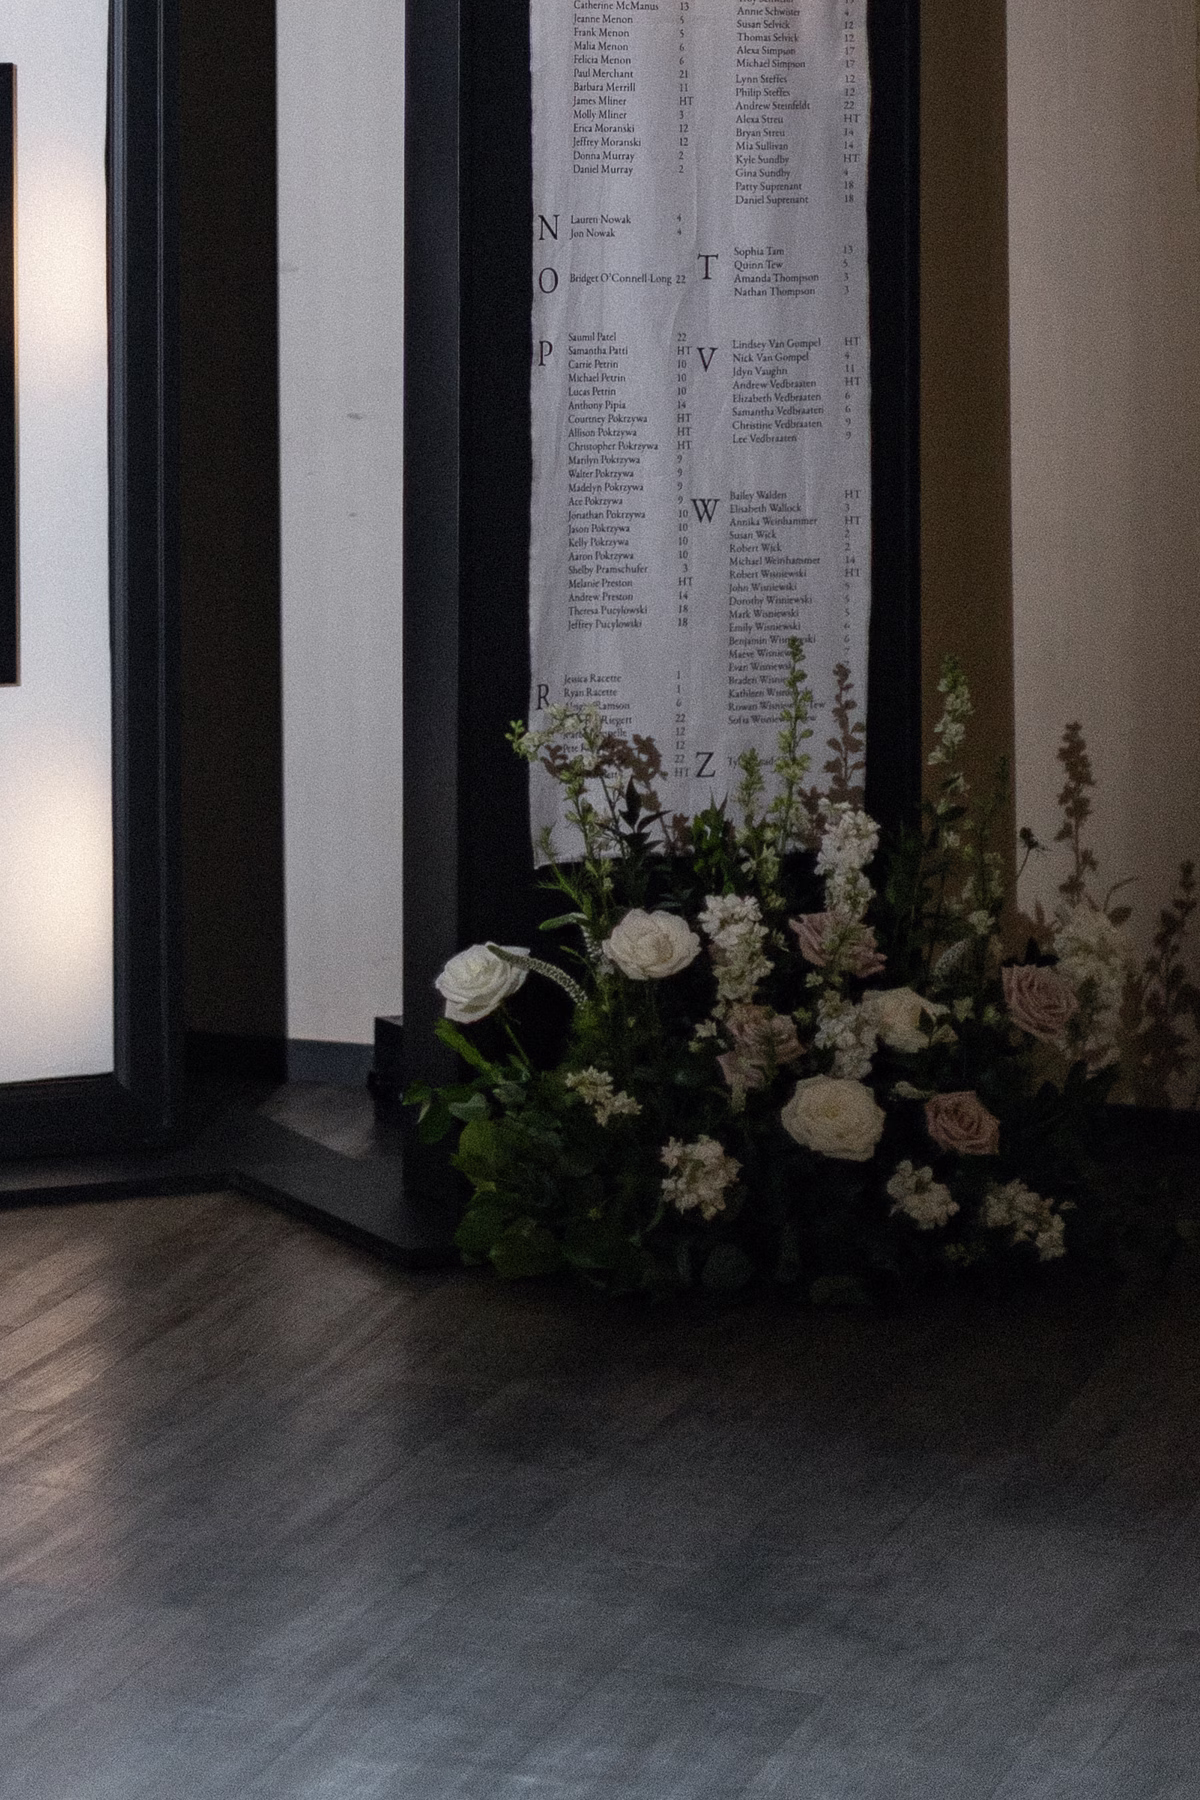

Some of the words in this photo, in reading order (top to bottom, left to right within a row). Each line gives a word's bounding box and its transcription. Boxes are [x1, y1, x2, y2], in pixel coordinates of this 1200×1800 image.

[574, 1, 613, 10] Catherine
[616, 1, 658, 10] McManus
[680, 2, 689, 10] 13
[574, 83, 604, 92] Barbara
[606, 83, 635, 92] Merrill
[680, 84, 688, 92] 11
[572, 97, 596, 108] James
[599, 97, 626, 105] Mliner
[679, 97, 694, 105] HT
[736, 142, 753, 150] Mia
[755, 142, 788, 150] Sullivan
[844, 142, 853, 150] 14
[573, 165, 599, 174] Daniel
[601, 165, 633, 176] Murray
[679, 165, 683, 173] 2
[538, 214, 559, 240] N
[698, 254, 718, 280] T
[539, 268, 559, 293] O
[734, 275, 771, 283] Amanda
[773, 273, 819, 285] Thompson
[538, 341, 553, 366] P
[568, 346, 606, 355] Samantha
[609, 346, 628, 354] Patti
[677, 346, 692, 354] HT
[697, 348, 718, 372] V
[568, 401, 602, 411] Anthony
[605, 401, 625, 412] Pipia
[677, 401, 686, 409] 14
[691, 499, 720, 523] W
[569, 565, 593, 576] Shelby
[597, 565, 648, 574] Pramschufer
[683, 564, 688, 572] 3
[537, 684, 550, 710] R
[695, 752, 716, 778] Z
